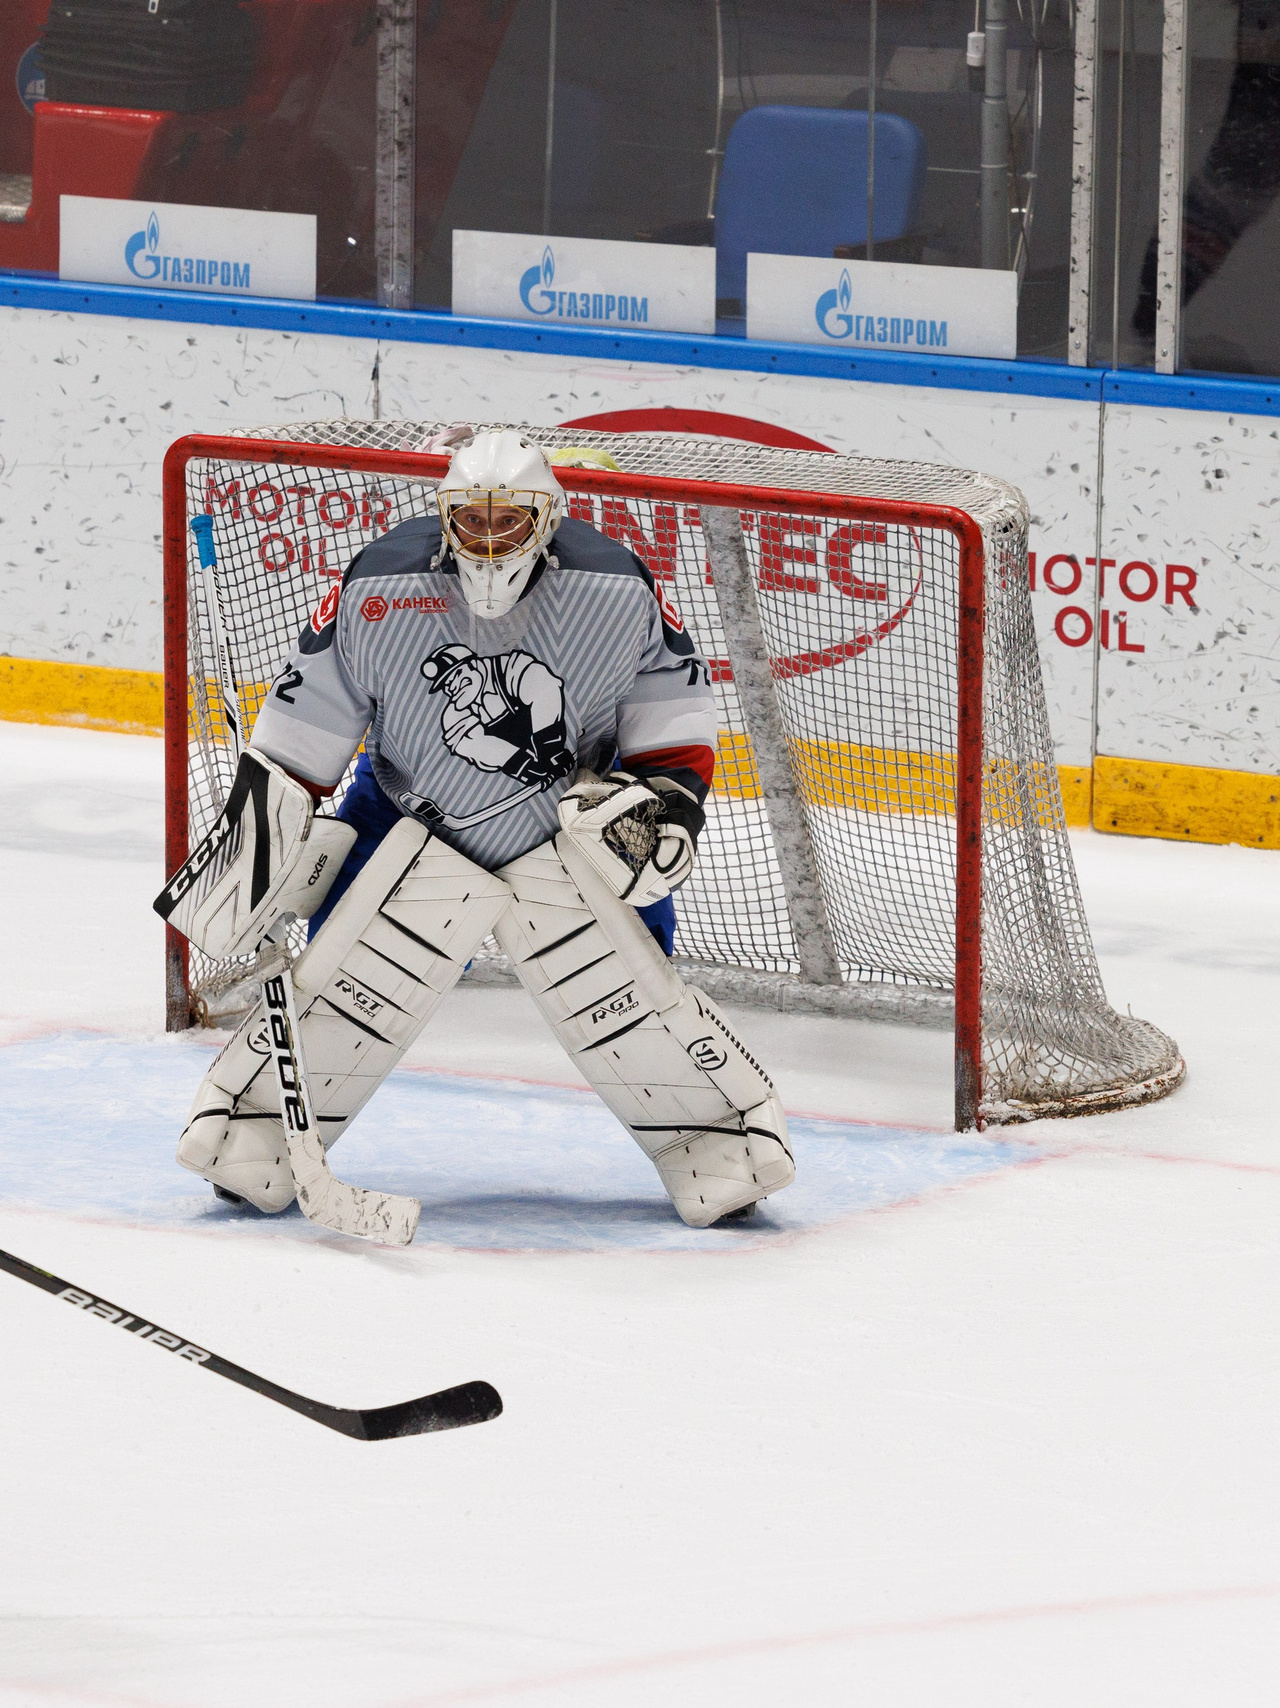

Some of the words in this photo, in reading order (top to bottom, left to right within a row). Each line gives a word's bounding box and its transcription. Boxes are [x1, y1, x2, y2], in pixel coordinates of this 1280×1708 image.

[162, 257, 250, 289] ГАЗПРОМ
[557, 290, 649, 323] ГАЗПРОМ
[855, 314, 948, 347] ГАЗПРОМ
[206, 476, 393, 533] MOTOR
[258, 532, 344, 577] OIL
[1054, 605, 1146, 654] OIL
[167, 813, 231, 902] CCM
[353, 1001, 376, 1018] PRO
[618, 1000, 640, 1017] PRO
[704, 1007, 774, 1090] WARRIOR
[55, 1286, 213, 1367] BAUER
